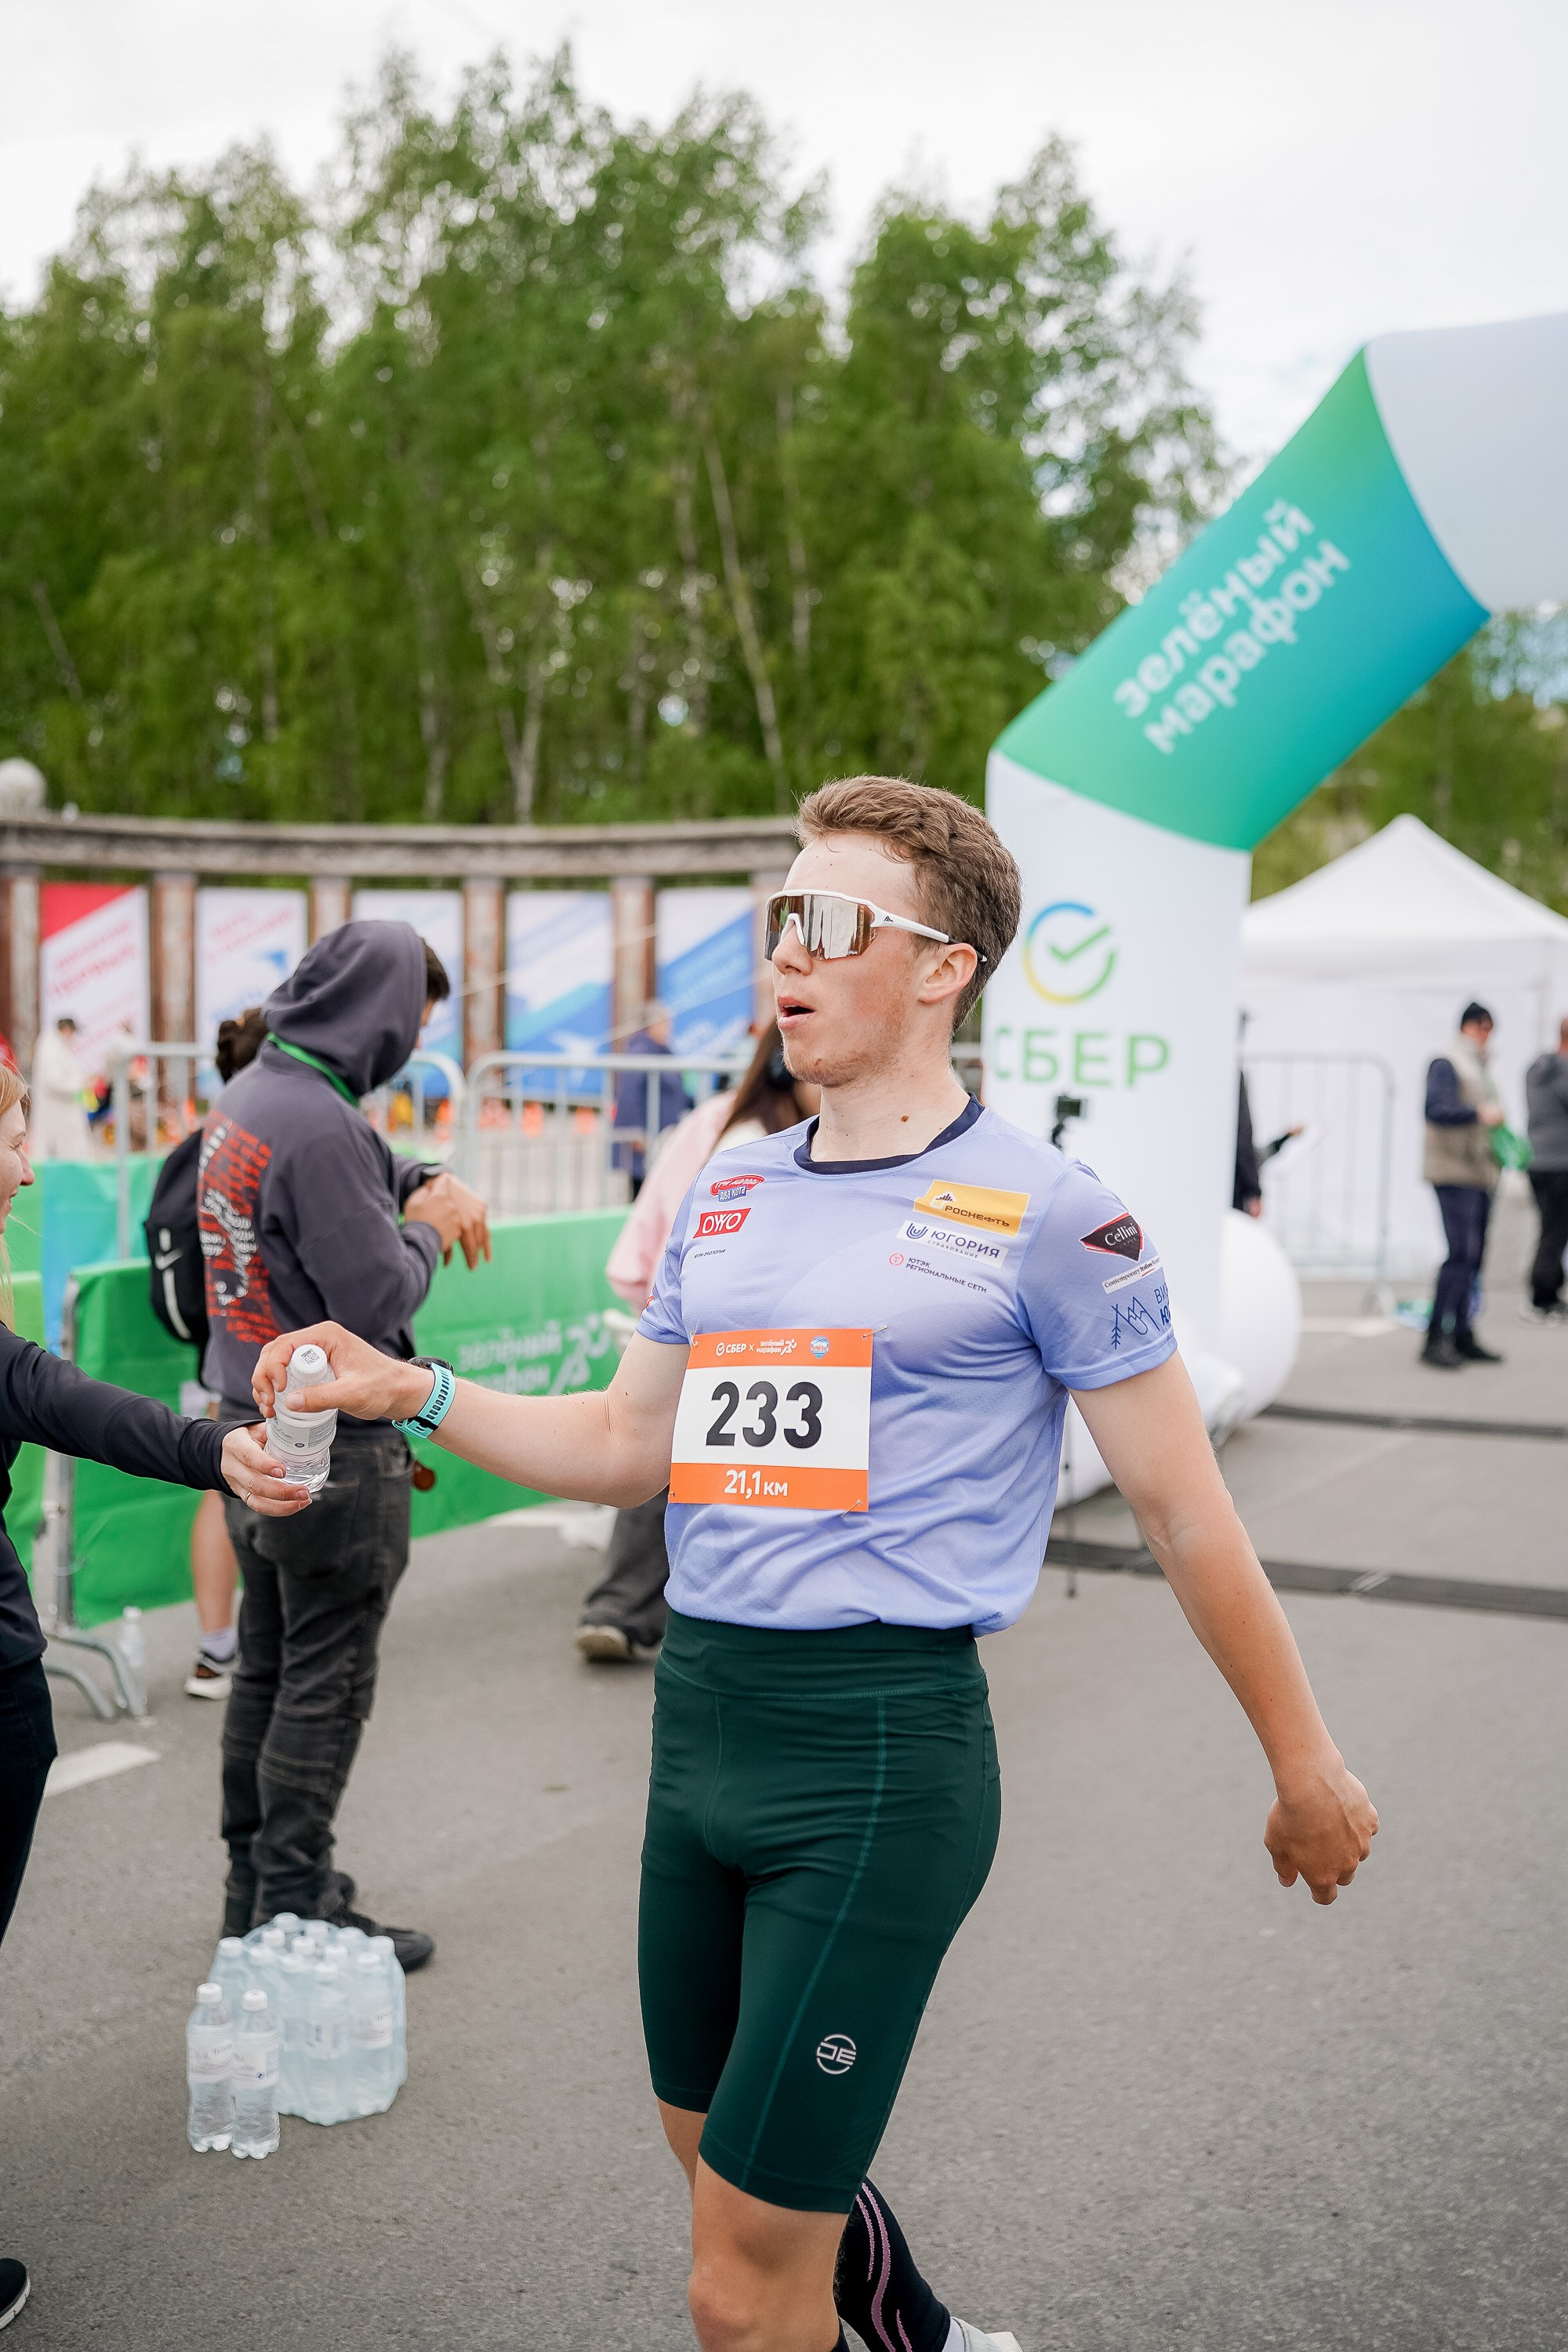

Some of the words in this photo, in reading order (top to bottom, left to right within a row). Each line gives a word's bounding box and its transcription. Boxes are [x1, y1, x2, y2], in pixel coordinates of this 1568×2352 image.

[1113, 499, 1316, 718] зелёный
[1145, 539, 1352, 755] марафон
[992, 1026, 1171, 1089] СБЕР
[945, 1205, 1010, 1227] РОСНЕФТЬ
[931, 1230, 1000, 1259] ЮГОРИЯ
[1105, 1222, 1138, 1246] Cellini
[909, 1258, 931, 1269] ЮТЭК
[906, 1263, 966, 1286] РЕГИОНАЛЬНЫЕ
[967, 1282, 987, 1294] СЕТИ
[1104, 1268, 1141, 1289] Contemporary
[725, 1342, 747, 1354] СБЕР
[706, 1381, 823, 1449] 233
